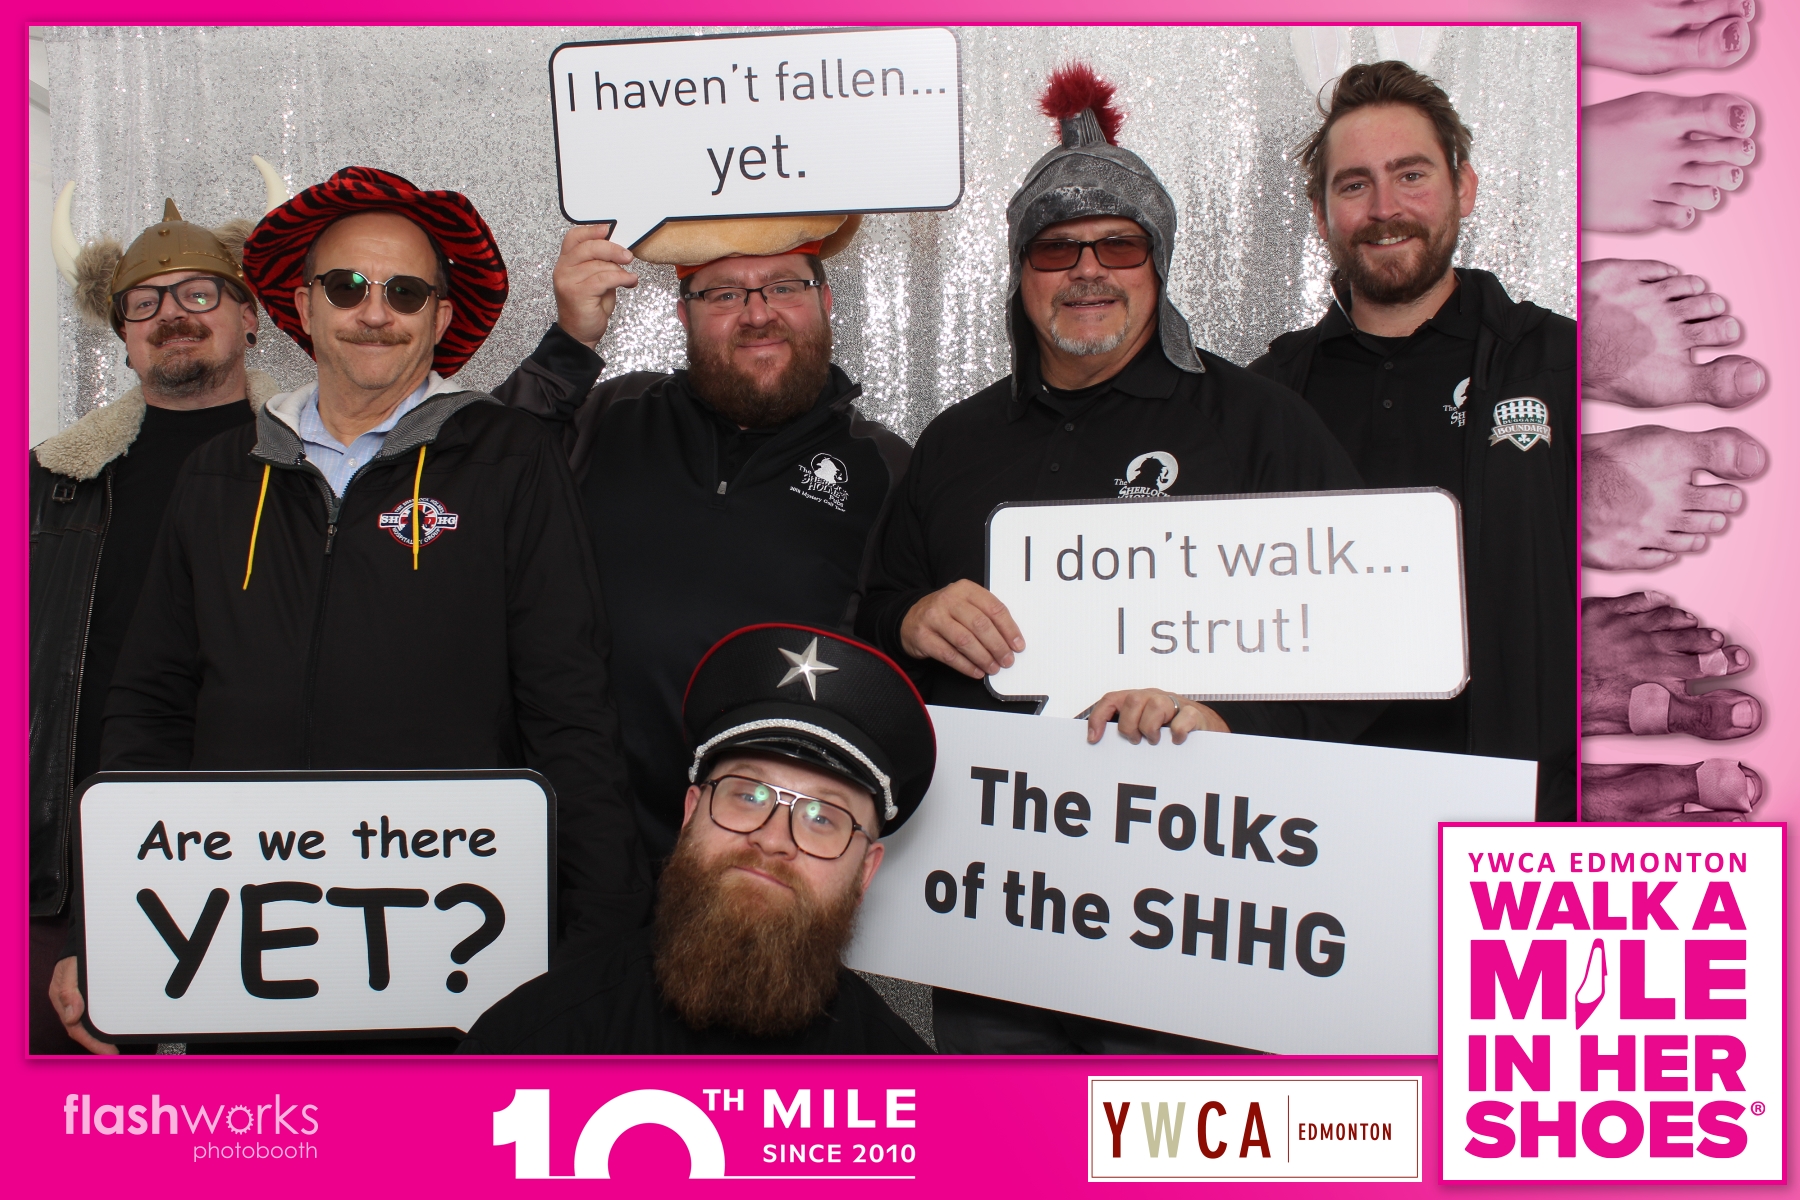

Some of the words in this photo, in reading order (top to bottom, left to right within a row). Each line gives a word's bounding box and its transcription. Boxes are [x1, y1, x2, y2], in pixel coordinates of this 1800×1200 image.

[566, 72, 577, 112] I
[594, 63, 760, 112] haven't
[706, 134, 806, 196] yet.
[1443, 404, 1458, 412] The
[1497, 424, 1549, 435] BOUNDARY
[798, 464, 812, 475] The
[1114, 478, 1128, 486] The
[381, 514, 399, 524] SH
[437, 516, 457, 525] HG
[1022, 534, 1032, 582] I
[1056, 531, 1198, 582] don't
[1116, 606, 1126, 655] I
[1149, 603, 1310, 656] strut!
[136, 819, 233, 862] Are
[258, 829, 327, 862] we
[351, 815, 498, 862] there
[969, 765, 1092, 839] The
[1114, 782, 1319, 869] Folks
[135, 881, 507, 1001] YET?
[923, 861, 986, 921] of
[1002, 869, 1111, 941] the
[1129, 886, 1347, 979] SHHG
